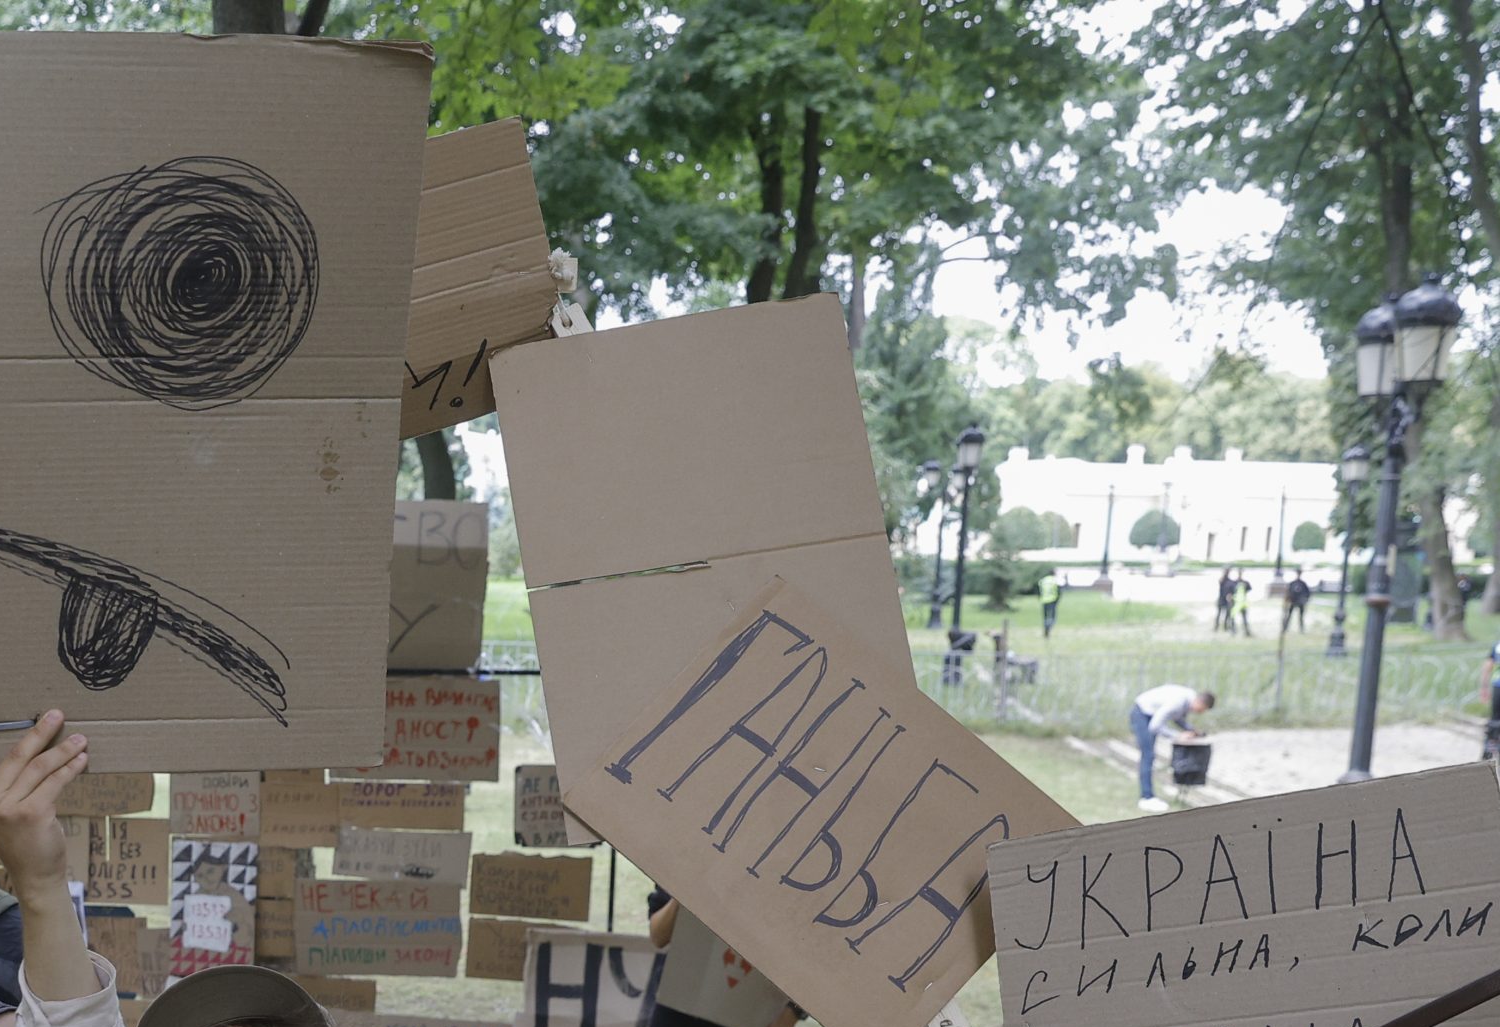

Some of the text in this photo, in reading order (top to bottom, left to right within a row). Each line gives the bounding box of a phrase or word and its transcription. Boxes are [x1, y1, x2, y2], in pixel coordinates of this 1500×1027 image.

[604, 609, 1010, 993] ГАНЬБА
[301, 883, 335, 914] НЕ
[1015, 808, 1425, 951] УКРАЇНА
[1020, 934, 1300, 1015] СИЛЬНА,
